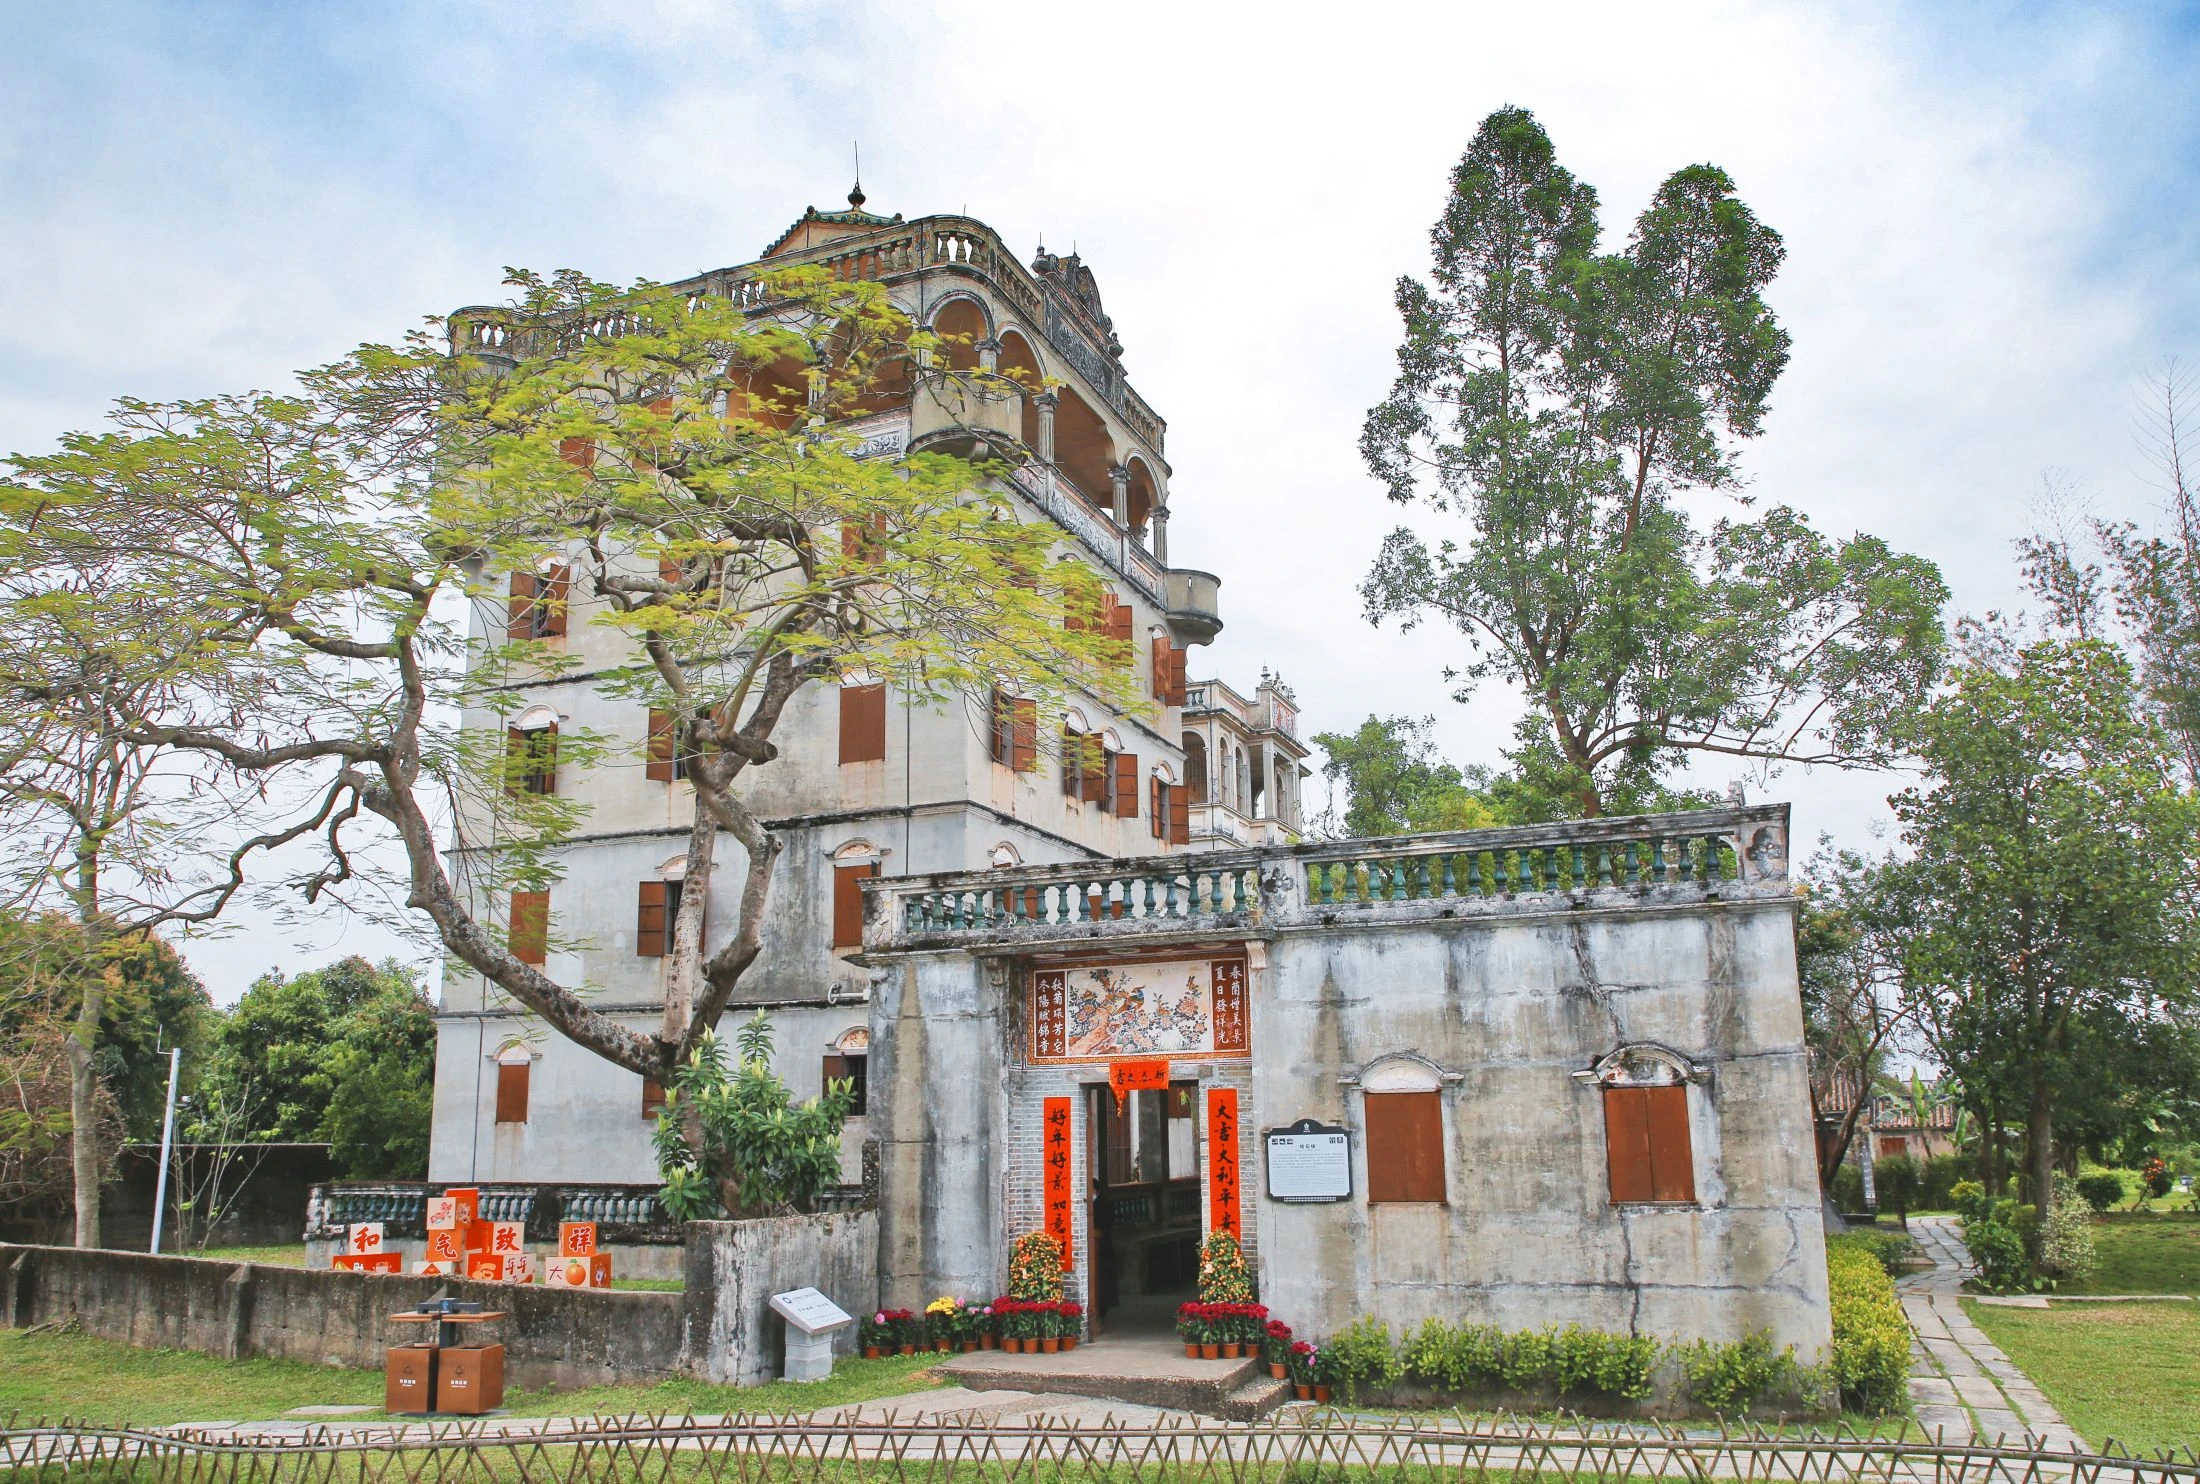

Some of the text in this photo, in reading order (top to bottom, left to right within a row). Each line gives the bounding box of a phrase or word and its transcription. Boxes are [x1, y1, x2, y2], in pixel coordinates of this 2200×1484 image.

[354, 1226, 592, 1259] 和 气 致 祥
